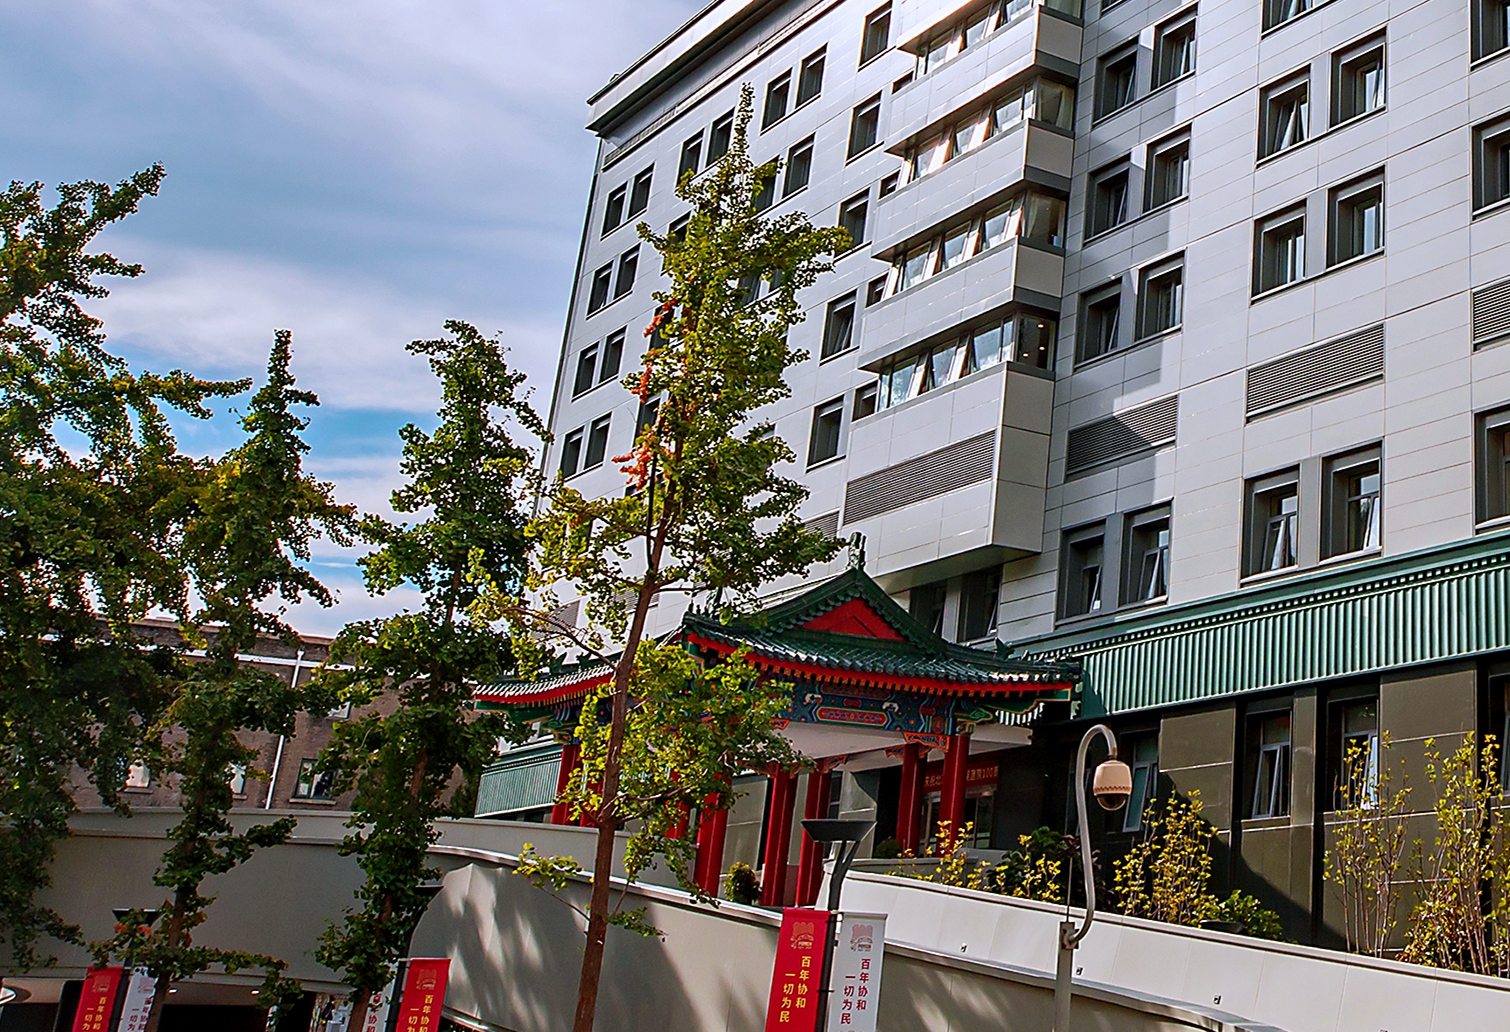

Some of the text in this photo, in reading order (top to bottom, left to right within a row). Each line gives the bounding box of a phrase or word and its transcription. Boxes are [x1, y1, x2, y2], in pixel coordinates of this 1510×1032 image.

[779, 973, 795, 1022] 一切为民
[795, 956, 811, 1008] 百年协和
[840, 975, 856, 1024] 一切为民
[856, 959, 871, 1010] 百年协和
[93, 997, 106, 1030] 百年协和
